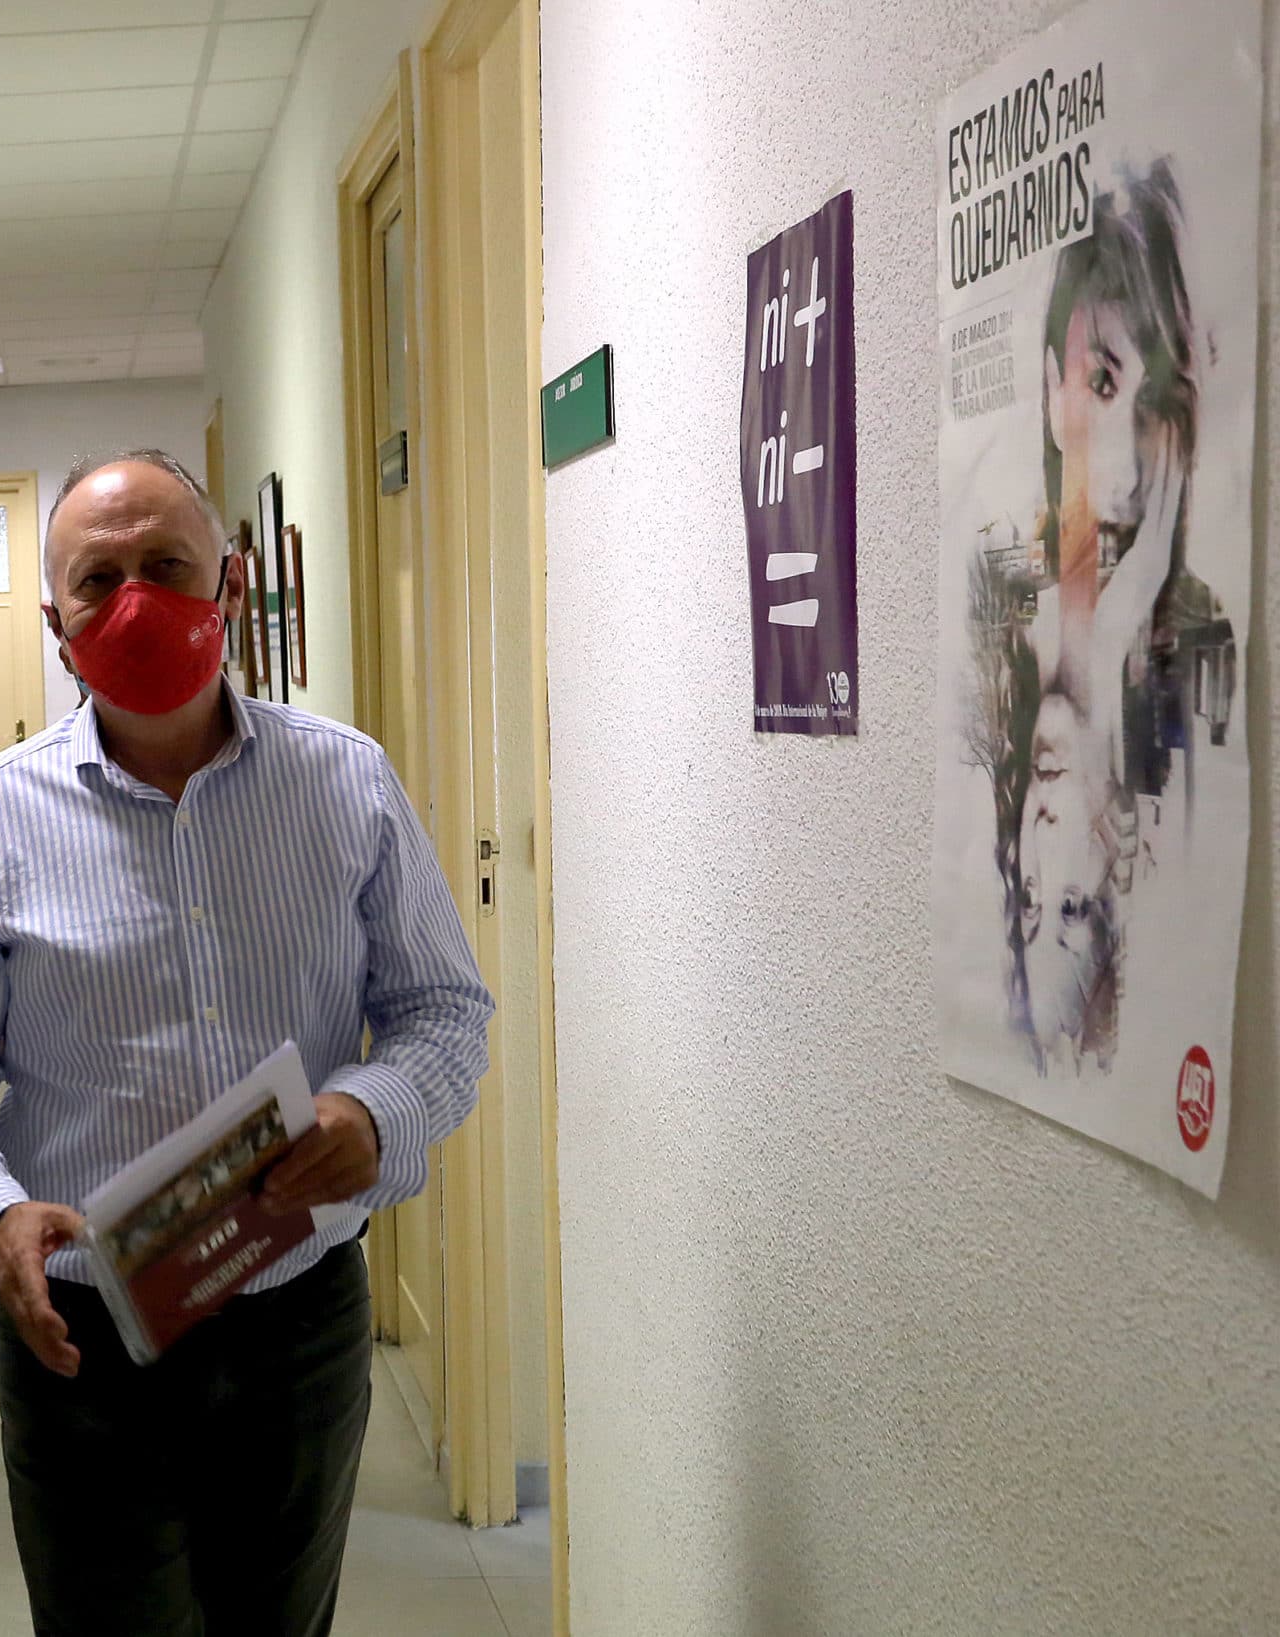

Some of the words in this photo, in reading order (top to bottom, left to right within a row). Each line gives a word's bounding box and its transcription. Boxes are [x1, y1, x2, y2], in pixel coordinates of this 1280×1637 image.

[949, 68, 1054, 204] ESTAMOS
[1056, 62, 1105, 145] PARA
[951, 142, 1090, 290] QUEDARNOS
